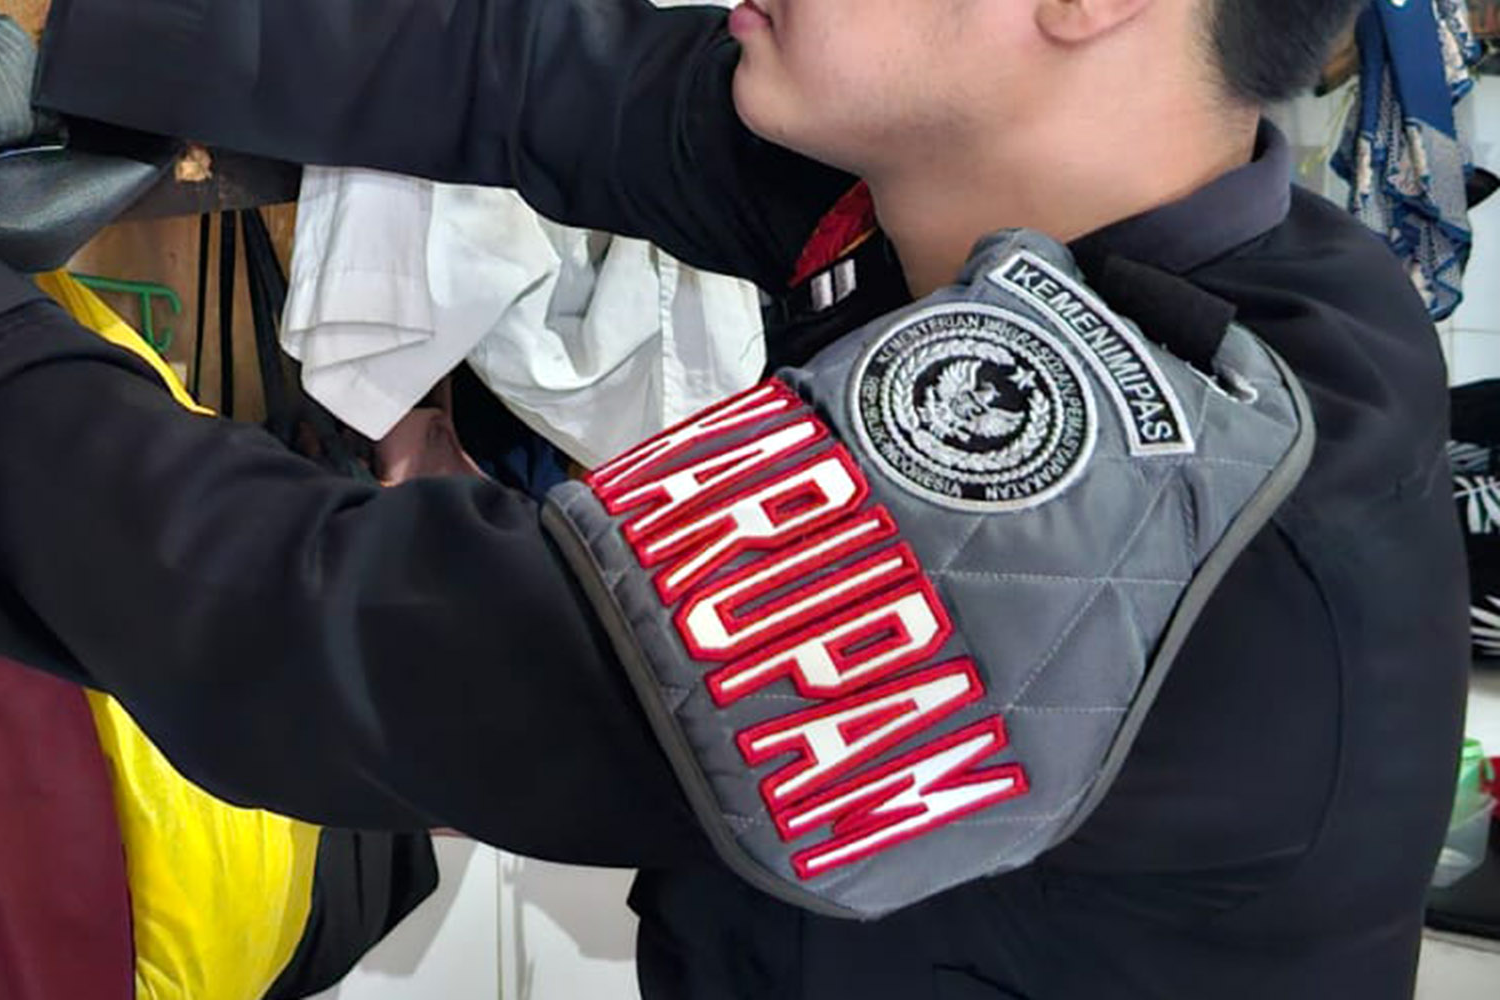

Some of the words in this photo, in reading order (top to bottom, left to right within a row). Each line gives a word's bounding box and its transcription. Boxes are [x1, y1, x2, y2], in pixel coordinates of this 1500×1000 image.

[876, 314, 980, 365] KEMENTERIAN
[1012, 263, 1174, 441] KEMENIMIPAS
[586, 378, 1028, 879] KARUPAM
